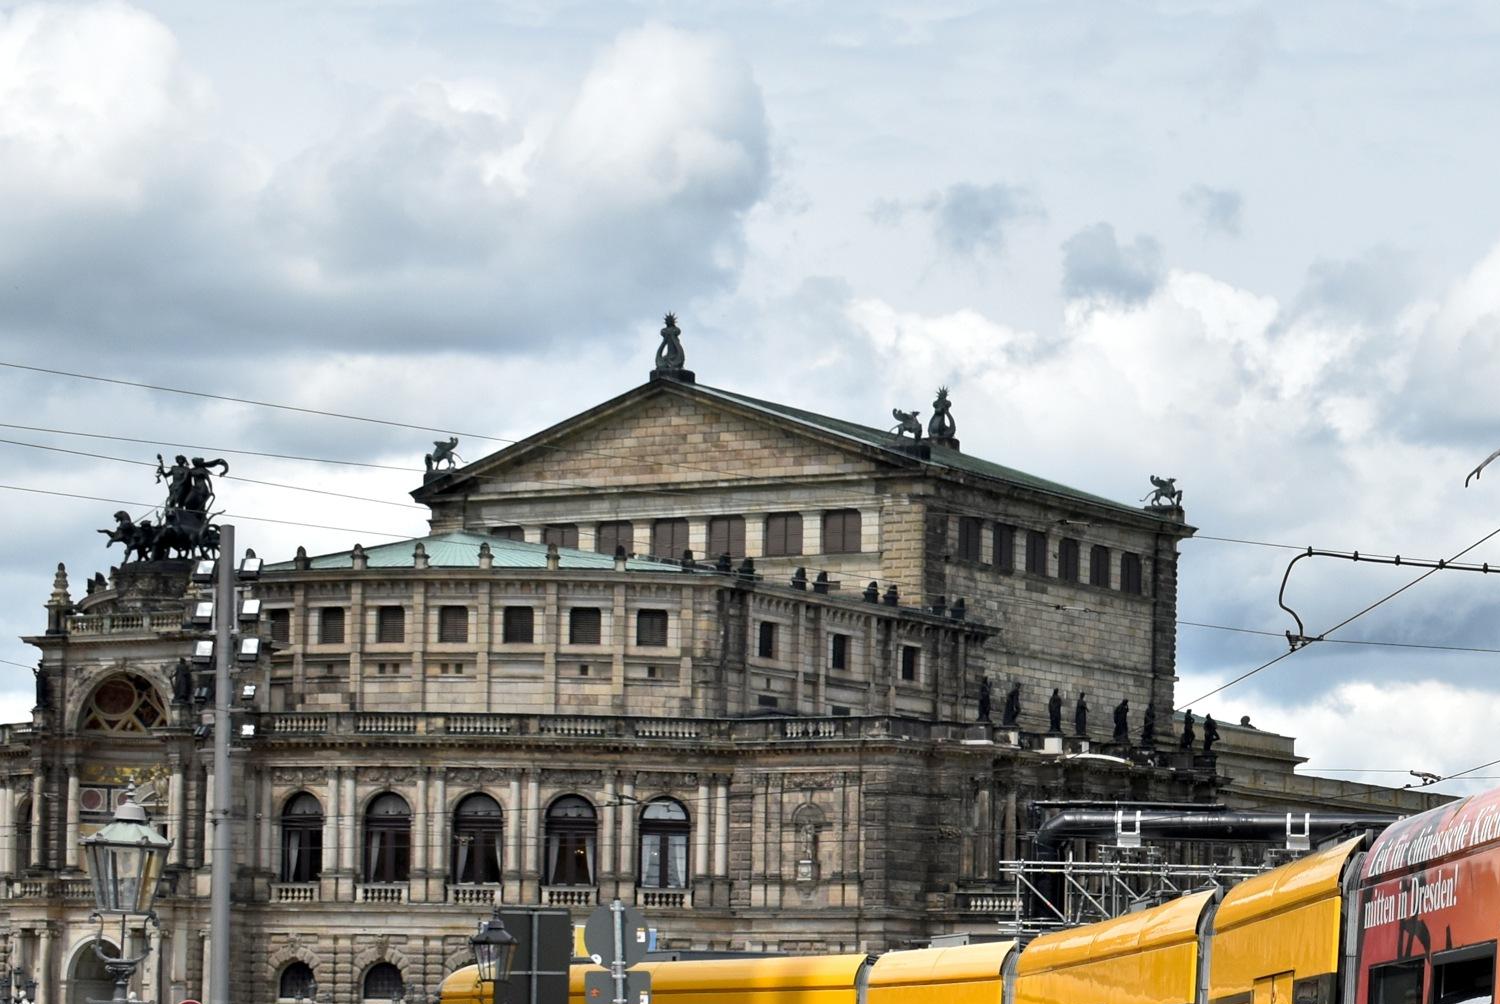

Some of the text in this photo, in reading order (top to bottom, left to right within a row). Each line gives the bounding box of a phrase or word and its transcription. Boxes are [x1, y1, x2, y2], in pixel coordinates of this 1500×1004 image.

[1368, 840, 1392, 878] Zeit
[1389, 835, 1410, 871] für
[1408, 813, 1470, 866] chinesische
[1364, 863, 1459, 929] mitten in Dresden!
